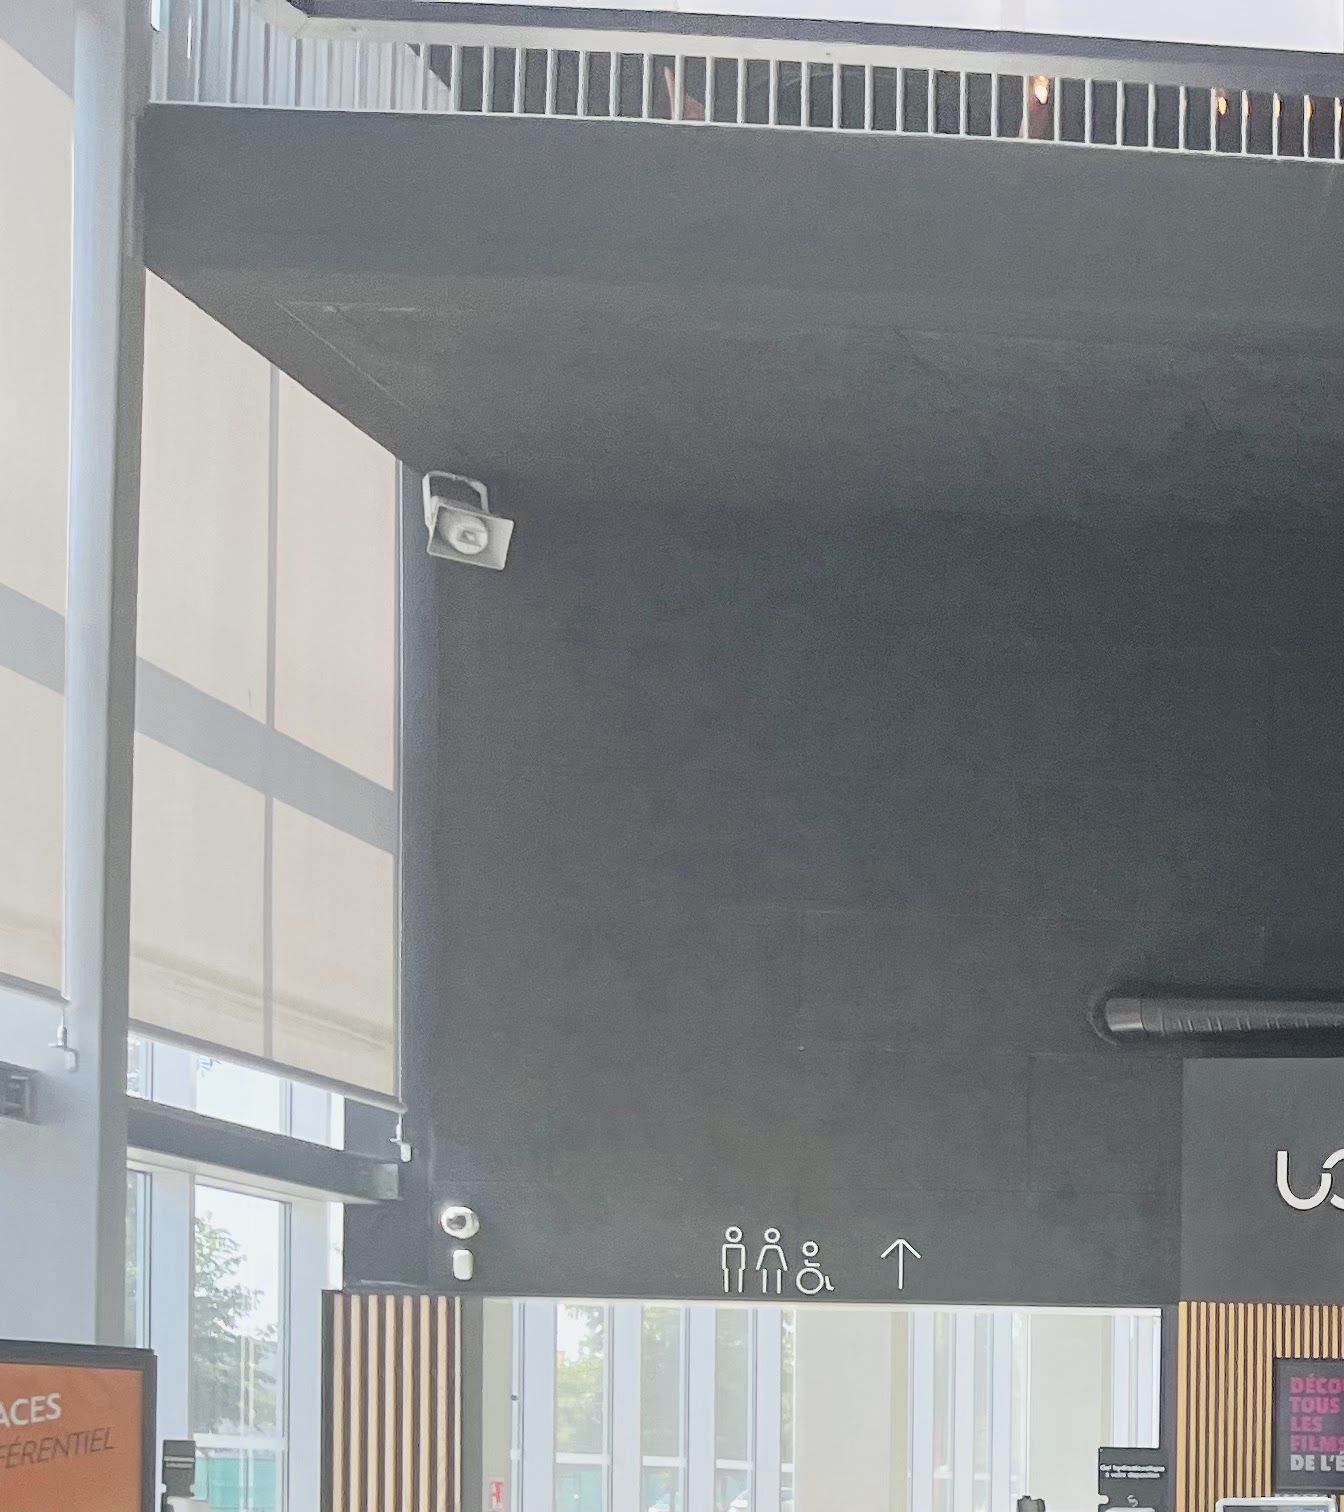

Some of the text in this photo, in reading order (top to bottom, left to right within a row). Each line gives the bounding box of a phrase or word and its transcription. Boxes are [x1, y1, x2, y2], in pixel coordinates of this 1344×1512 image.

[1290, 1397, 1341, 1414] TOUS
[1290, 1416, 1324, 1432] LES
[1290, 1455, 1316, 1472] DE
